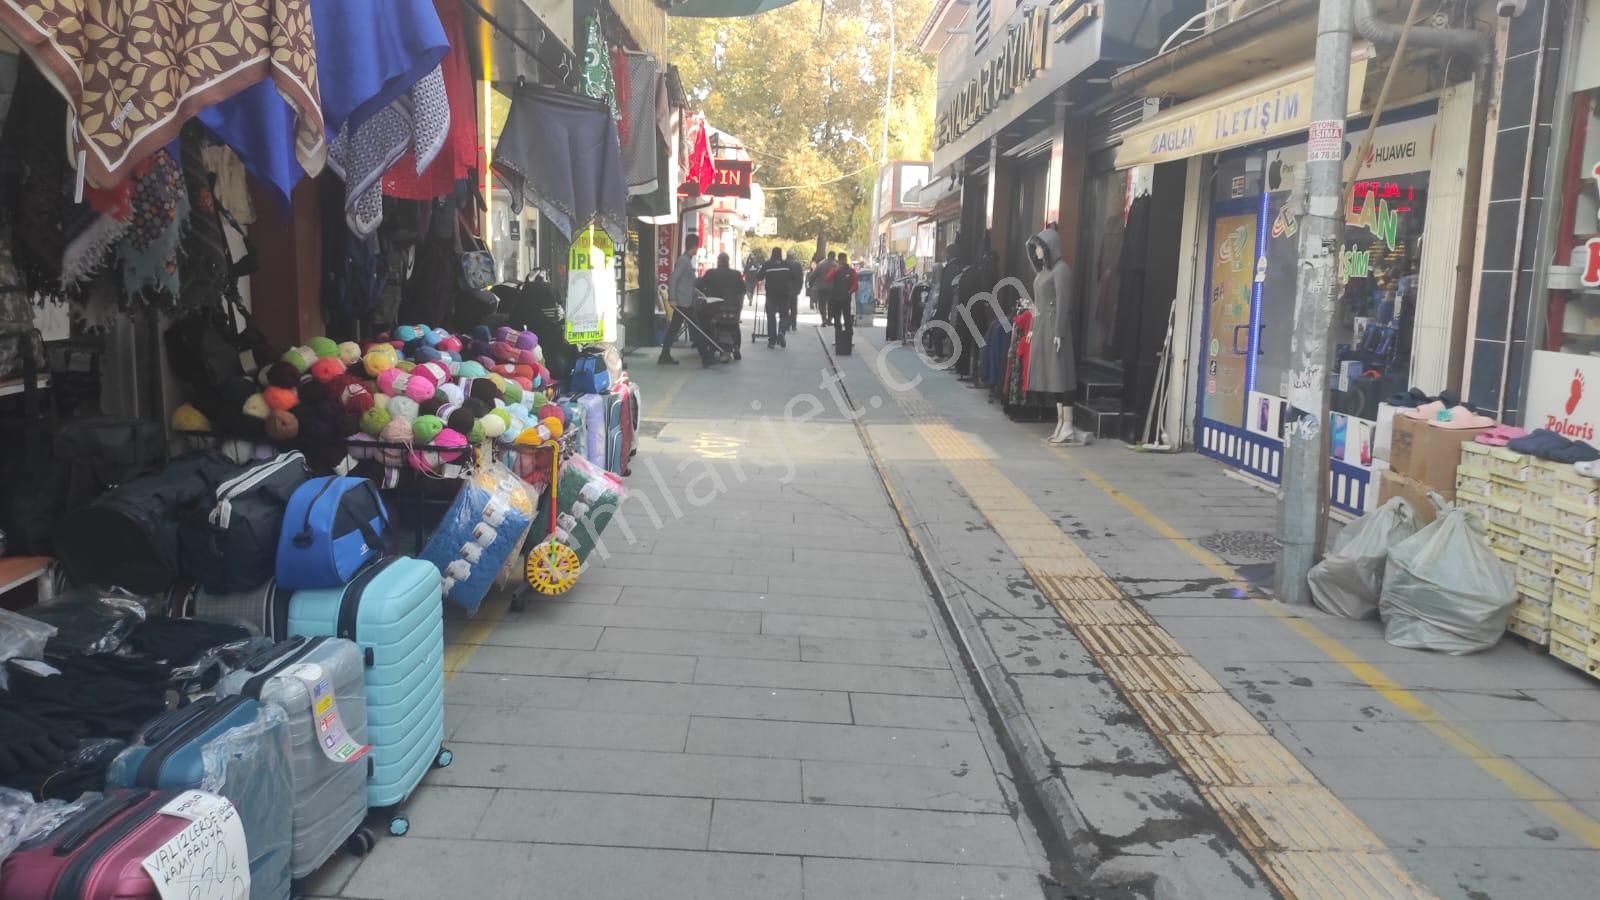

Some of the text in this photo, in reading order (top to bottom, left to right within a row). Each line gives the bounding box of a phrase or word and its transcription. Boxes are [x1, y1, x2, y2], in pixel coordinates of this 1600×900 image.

[1215, 90, 1299, 139] İLETİŞİM
[1374, 141, 1417, 163] HUAWEI
[1546, 415, 1593, 441] Polaris
